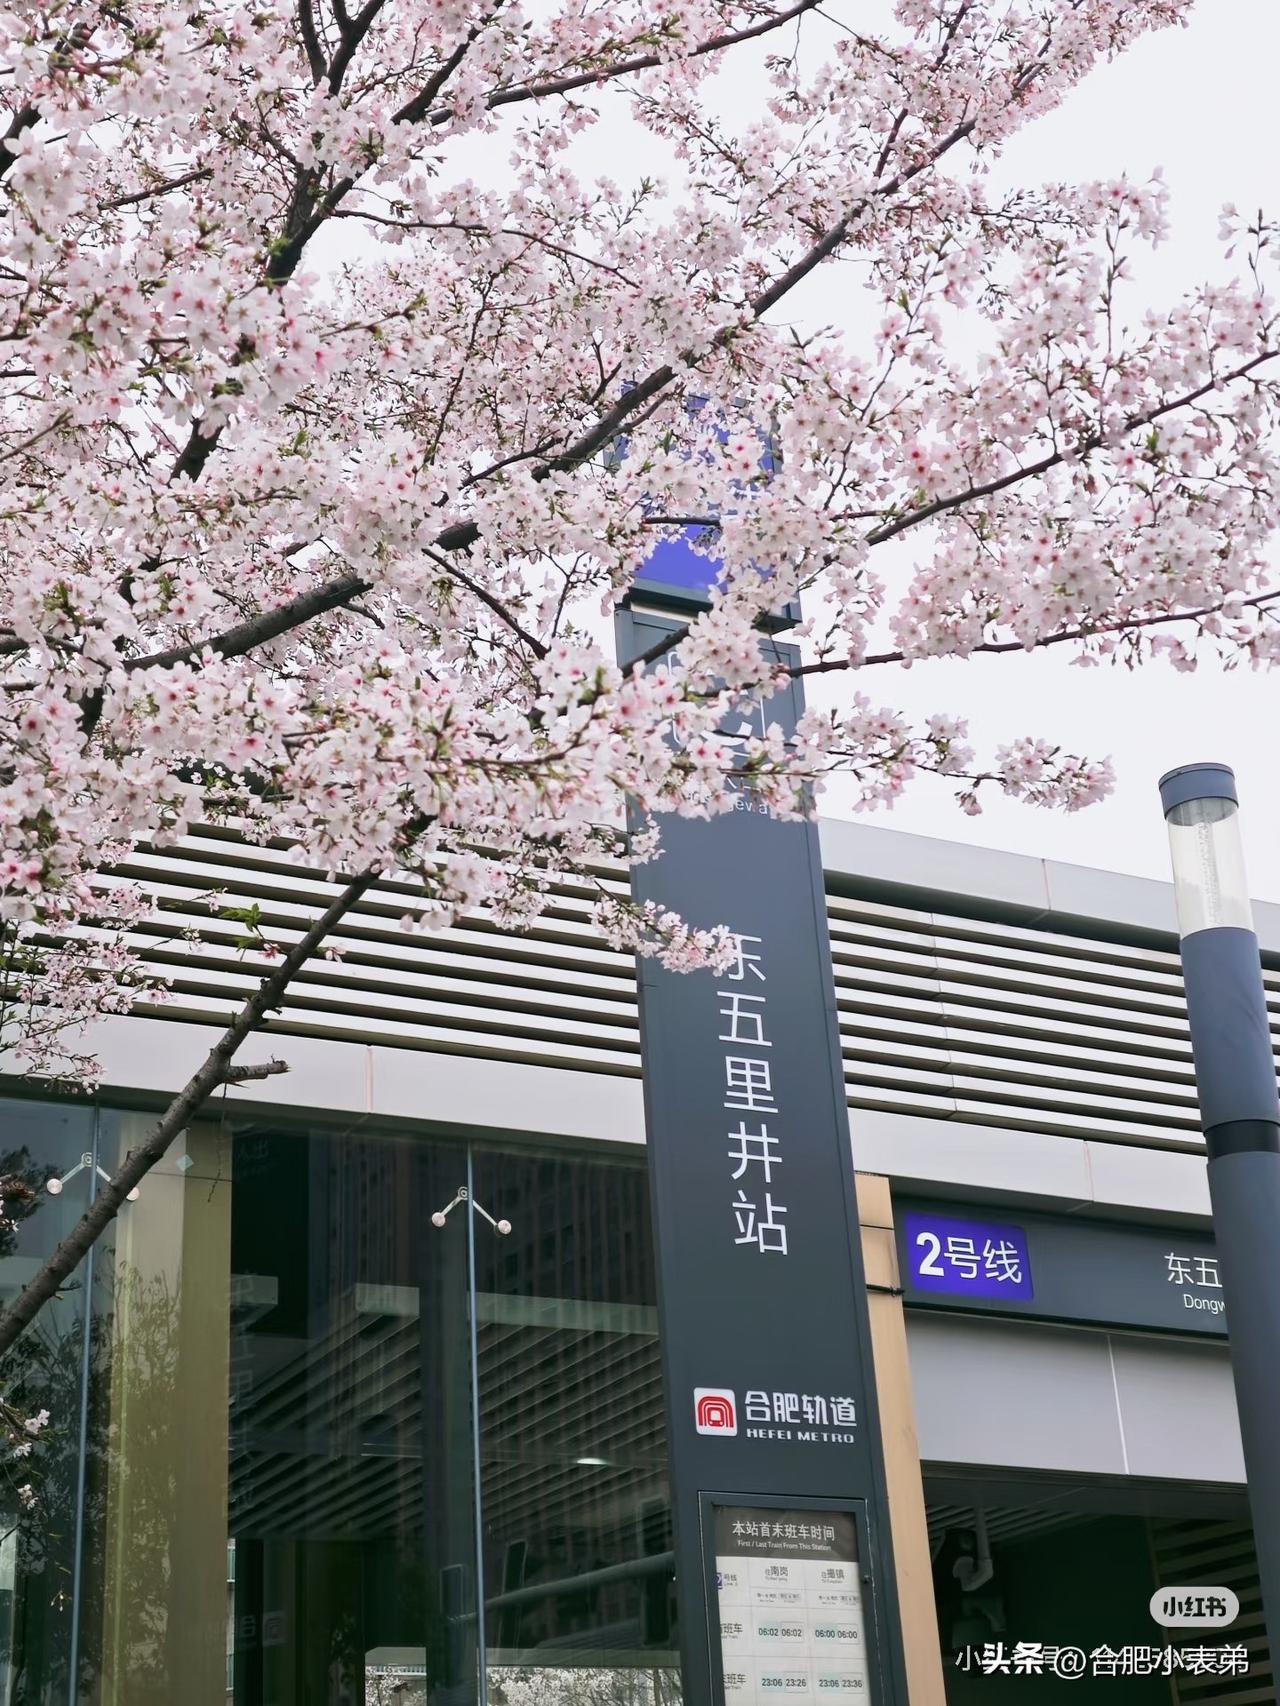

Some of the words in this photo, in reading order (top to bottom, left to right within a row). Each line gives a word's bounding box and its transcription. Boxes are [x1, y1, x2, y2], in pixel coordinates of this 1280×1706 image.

[717, 934, 788, 1255] 东五里井站
[915, 1230, 1022, 1283] 2号线
[1164, 1252, 1223, 1287] 东五
[745, 1390, 857, 1427] 合肥轨道
[747, 1428, 792, 1440] HEFEI
[797, 1431, 855, 1444] METRO
[732, 1520, 835, 1542] 本站首末班车时间
[737, 1540, 750, 1548] First
[755, 1541, 767, 1549] Last
[768, 1541, 783, 1549] Train
[783, 1542, 798, 1550] From
[799, 1543, 811, 1551] This
[812, 1543, 832, 1552] Station
[758, 1627, 779, 1637] 06:02
[781, 1628, 802, 1637] 06:02
[815, 1629, 836, 1639] 06:00
[837, 1630, 858, 1639] 06:00
[761, 1678, 783, 1687] 23:06
[785, 1678, 807, 1687] 23:26
[819, 1679, 840, 1688] 23:06
[842, 1679, 863, 1688] 23:36
